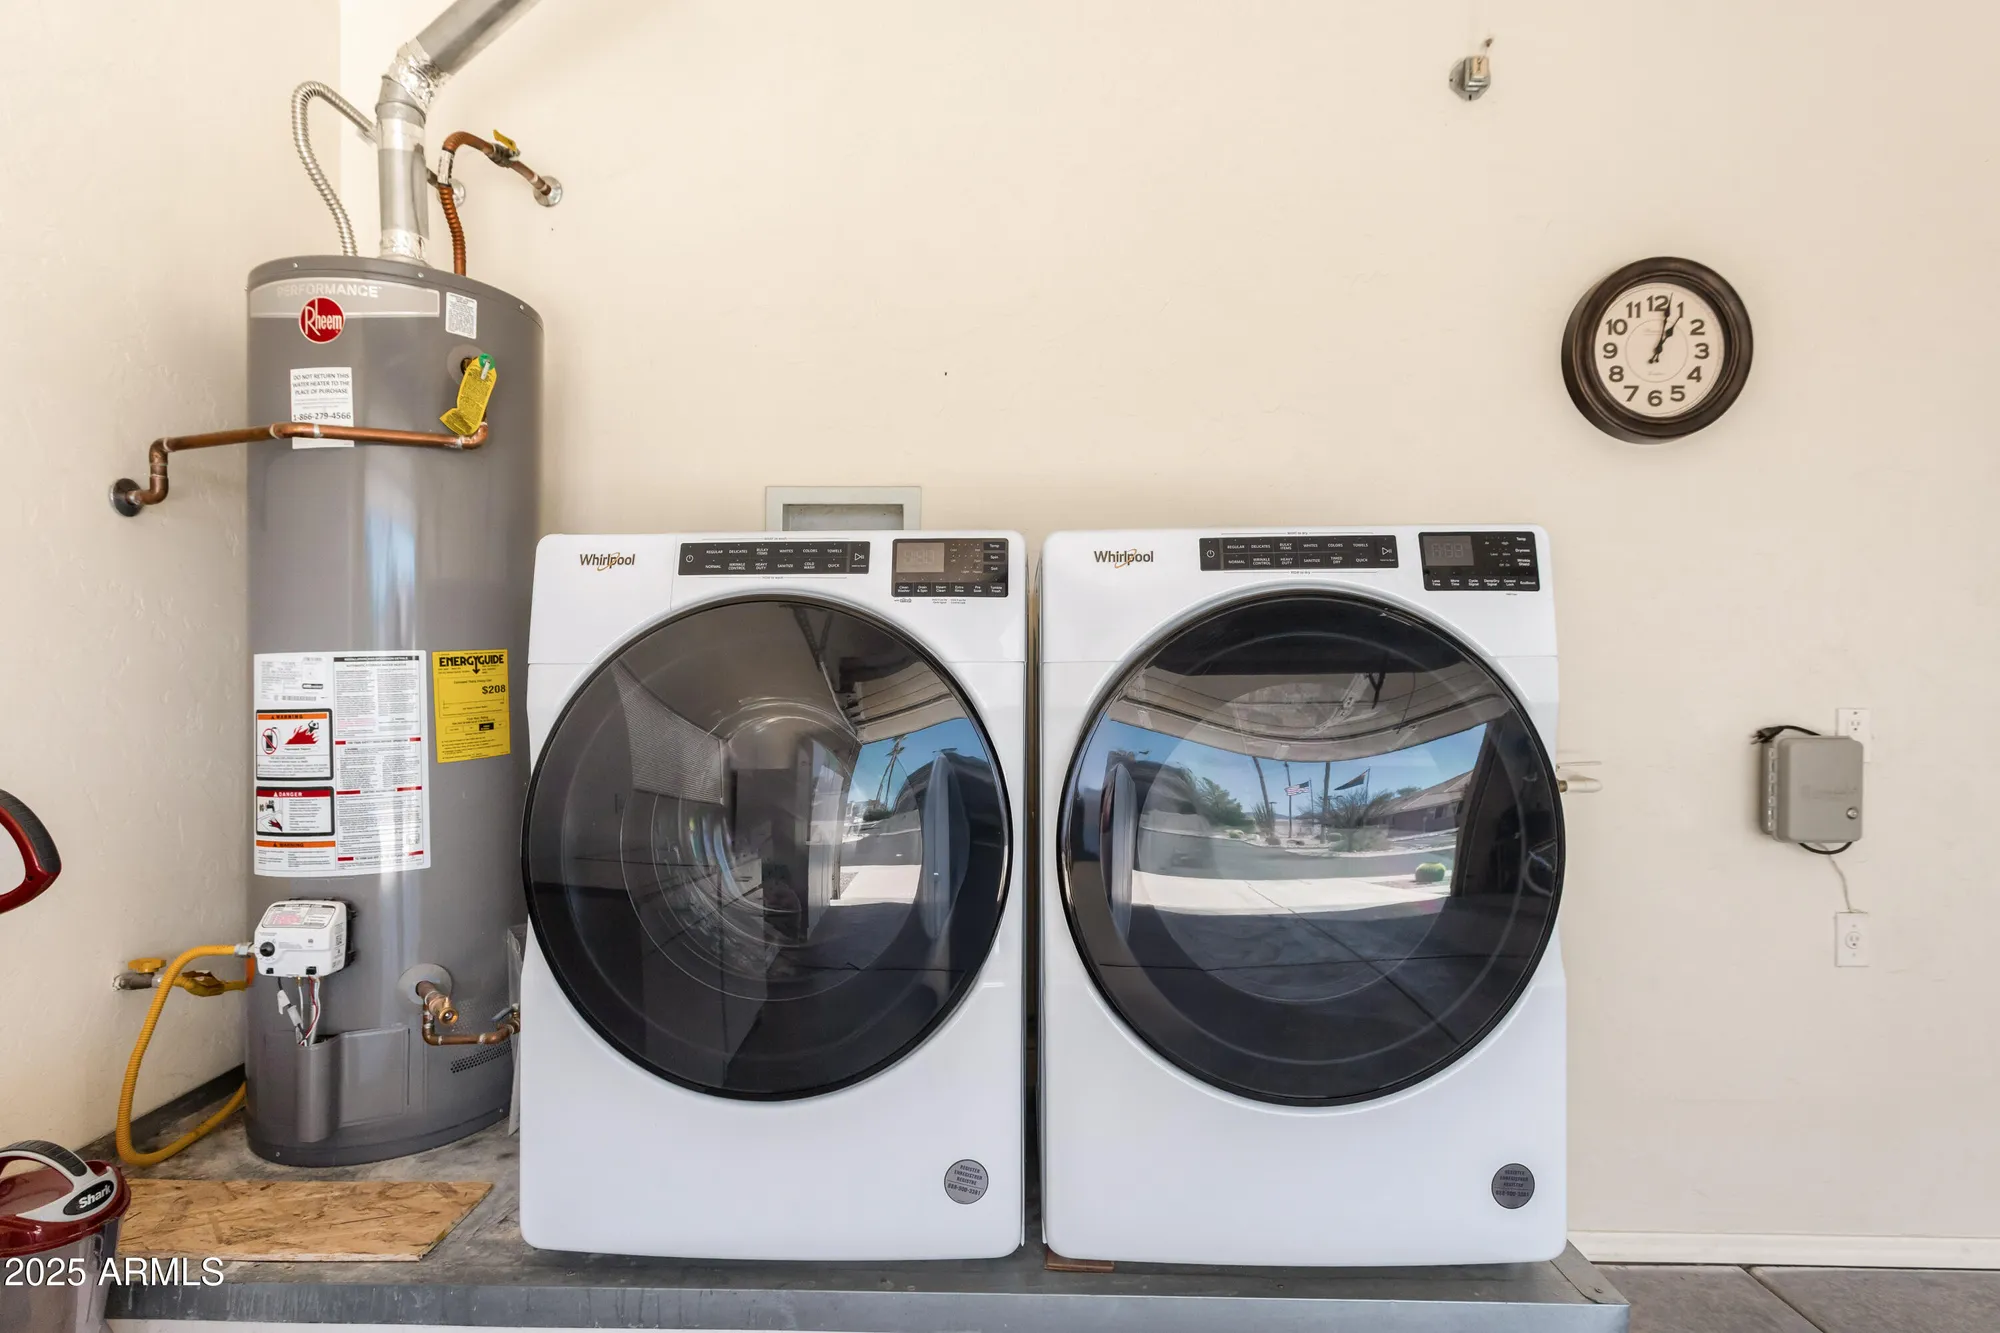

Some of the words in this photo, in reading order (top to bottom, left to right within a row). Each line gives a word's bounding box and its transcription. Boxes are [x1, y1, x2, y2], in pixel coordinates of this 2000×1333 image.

[277, 283, 379, 298] PERFORMANCE
[1626, 302, 1642, 318] 11
[1647, 296, 1669, 312] 12
[1677, 302, 1684, 318] 1
[305, 298, 342, 336] Rheem
[1606, 318, 1628, 336] 10
[1690, 319, 1705, 336] 2
[1603, 342, 1618, 359] 9
[1694, 343, 1710, 360] 3
[1608, 366, 1624, 382] 8
[1687, 366, 1702, 382] 4
[1624, 386, 1640, 402] 7
[1648, 390, 1663, 407] 6
[1670, 386, 1686, 402] 5
[293, 412, 351, 421] 1-866-279-4566
[580, 553, 636, 569] Whirlpool
[1094, 550, 1154, 566] Whirlpool
[482, 685, 506, 694] $208
[79, 1184, 110, 1208] Shark
